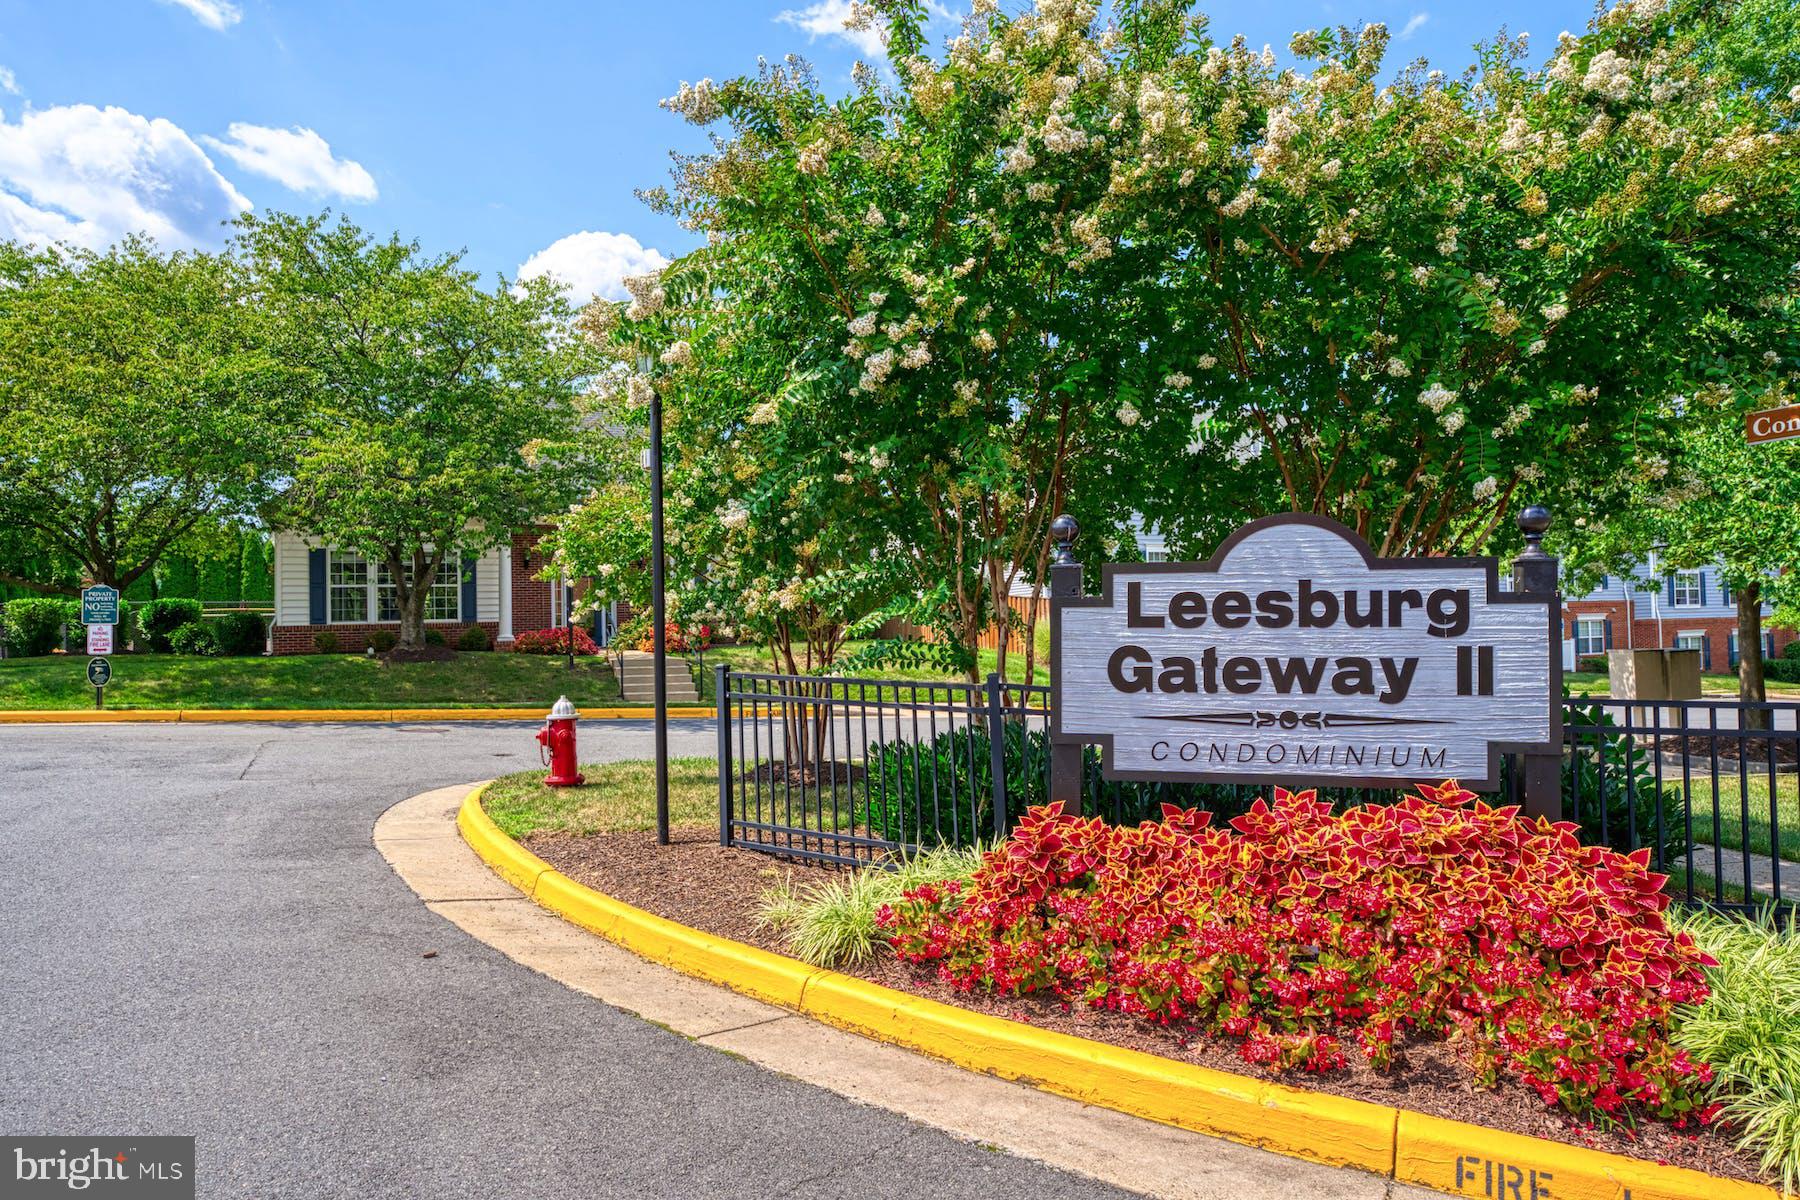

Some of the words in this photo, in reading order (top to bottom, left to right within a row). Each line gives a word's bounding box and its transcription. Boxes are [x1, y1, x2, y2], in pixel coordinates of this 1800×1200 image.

[1753, 417, 1800, 436] Con
[85, 602, 100, 611] NO
[1127, 579, 1470, 638] Leesburg
[1107, 645, 1419, 703] Gateway
[1456, 645, 1494, 696] II
[1151, 740, 1448, 768] CONDOMINIUM
[1456, 1156, 1553, 1200] FIRE
